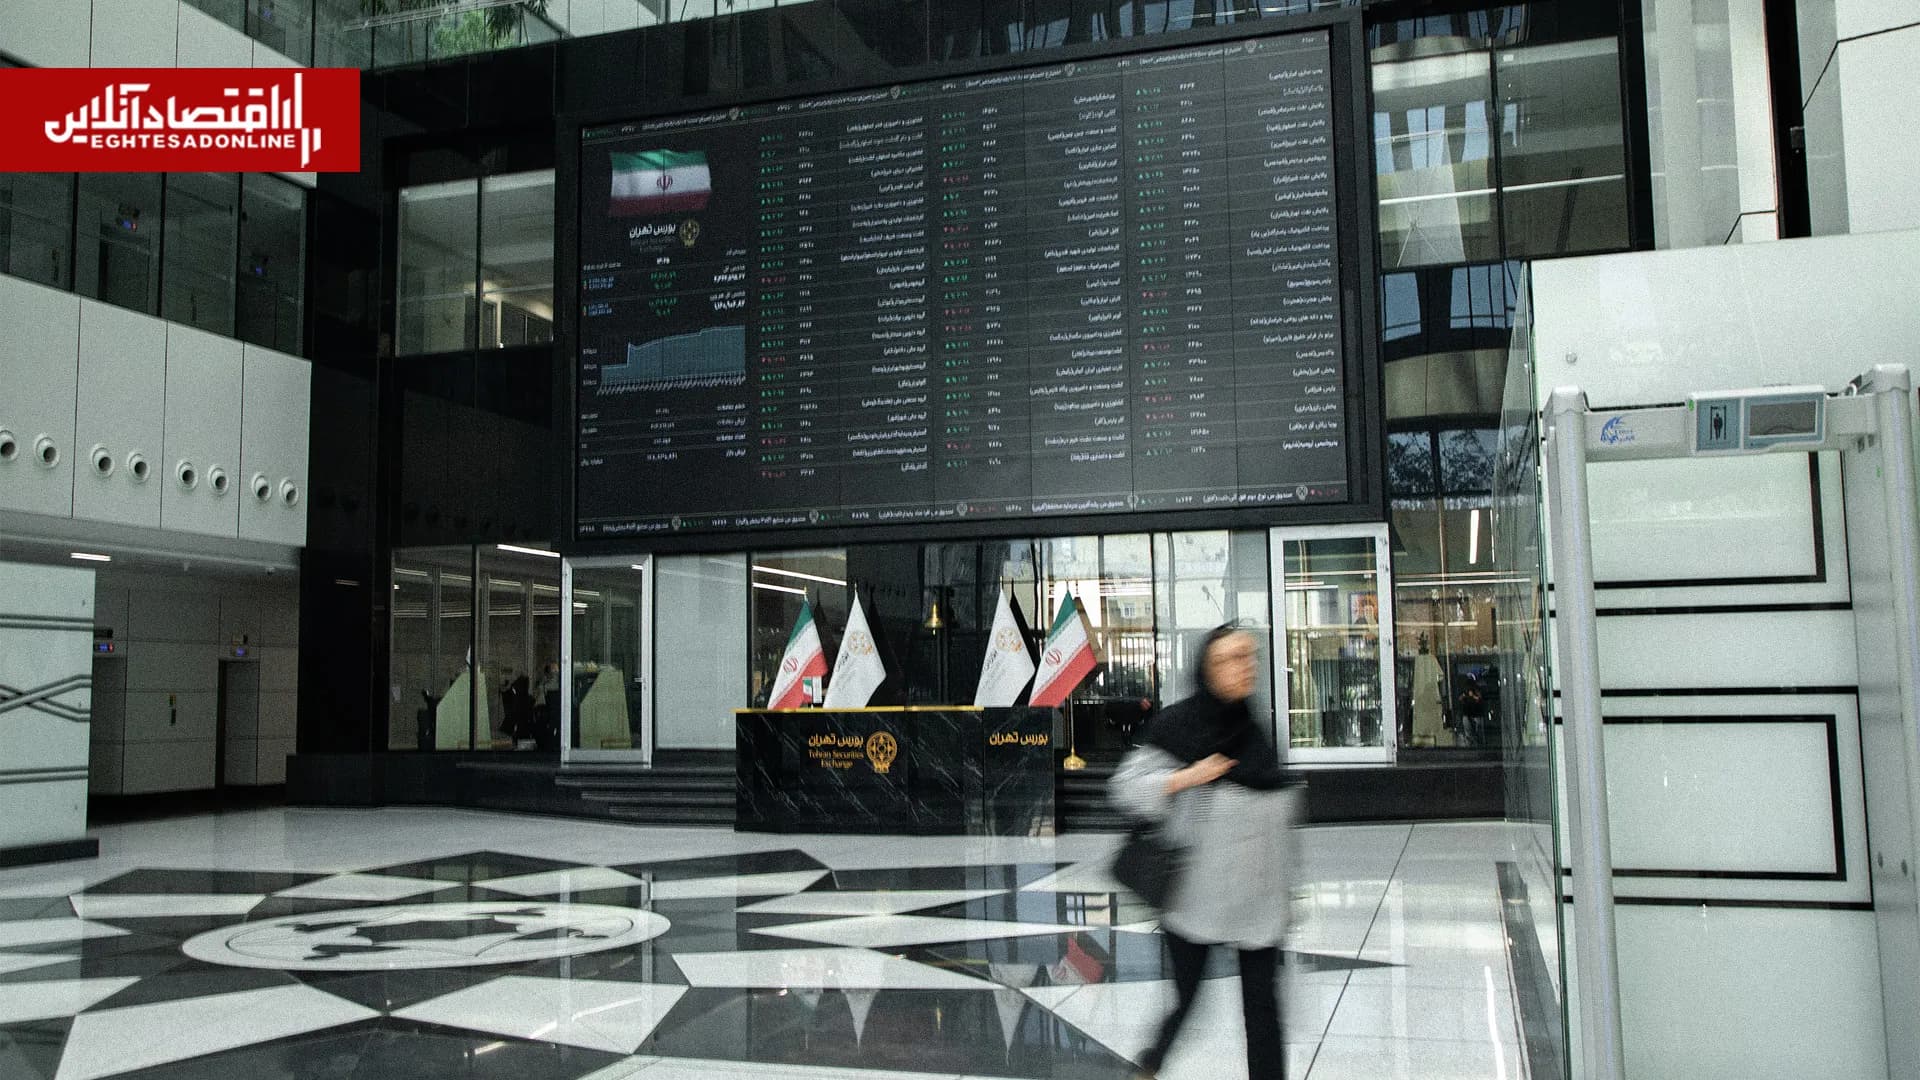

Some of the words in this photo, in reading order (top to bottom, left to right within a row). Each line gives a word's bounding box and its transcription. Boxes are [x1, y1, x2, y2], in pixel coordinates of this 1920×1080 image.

[629, 223, 652, 239] تهران
[808, 732, 836, 748] تهران
[837, 734, 864, 748] بورس
[989, 731, 1019, 746] تهران
[1020, 733, 1049, 746] بورس
